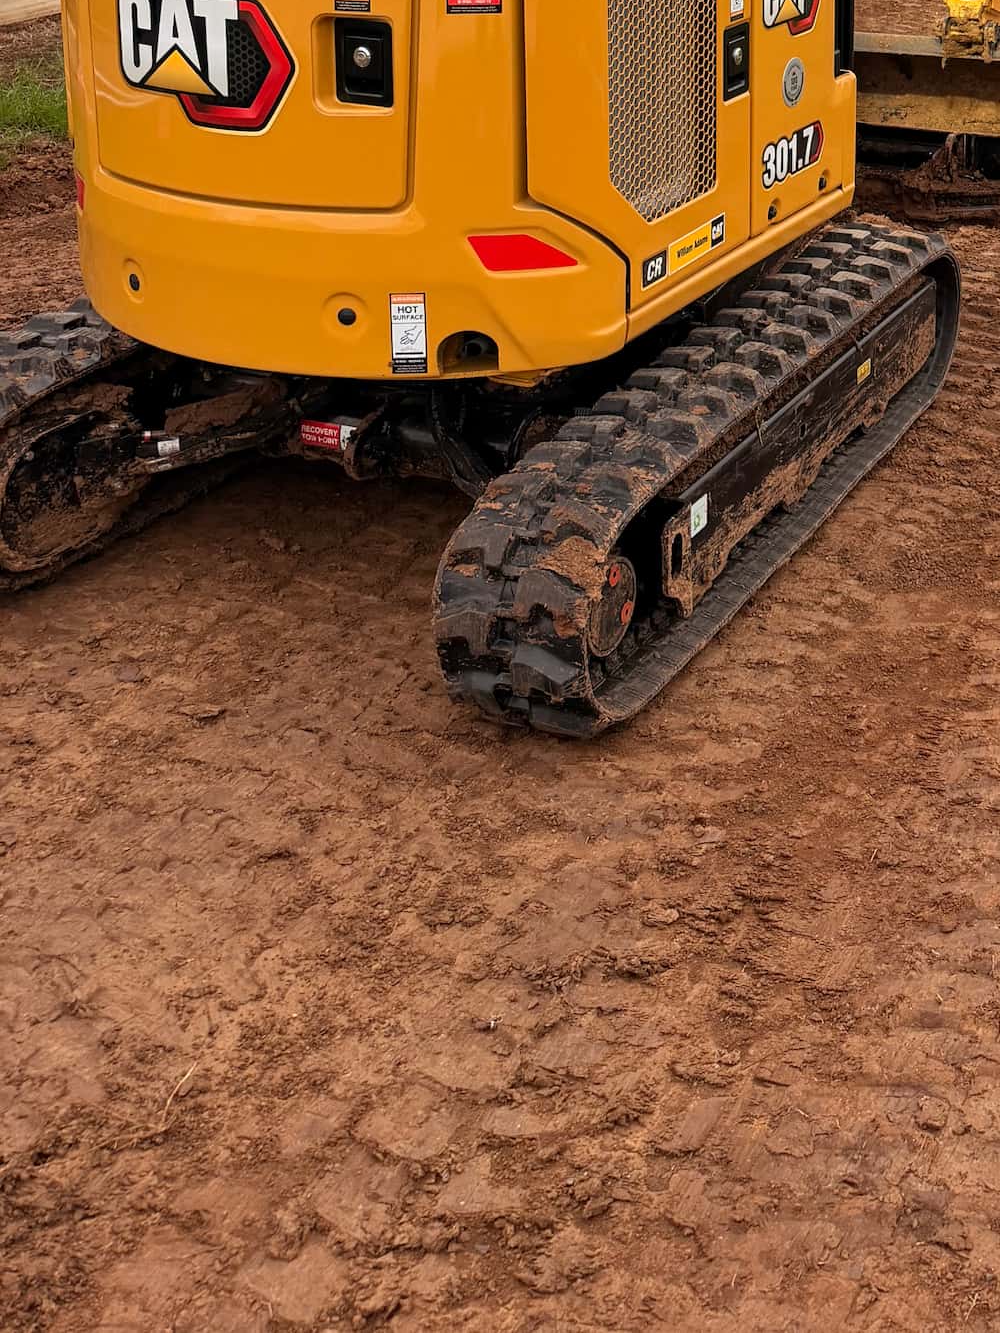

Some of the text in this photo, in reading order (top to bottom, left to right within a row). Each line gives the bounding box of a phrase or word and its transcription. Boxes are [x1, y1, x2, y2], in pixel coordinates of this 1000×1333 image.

[762, 124, 815, 188] 301.7
[711, 221, 724, 240] CAT
[646, 256, 663, 282] CR
[397, 305, 419, 314] HOT
[301, 424, 338, 437] RECOVERY
